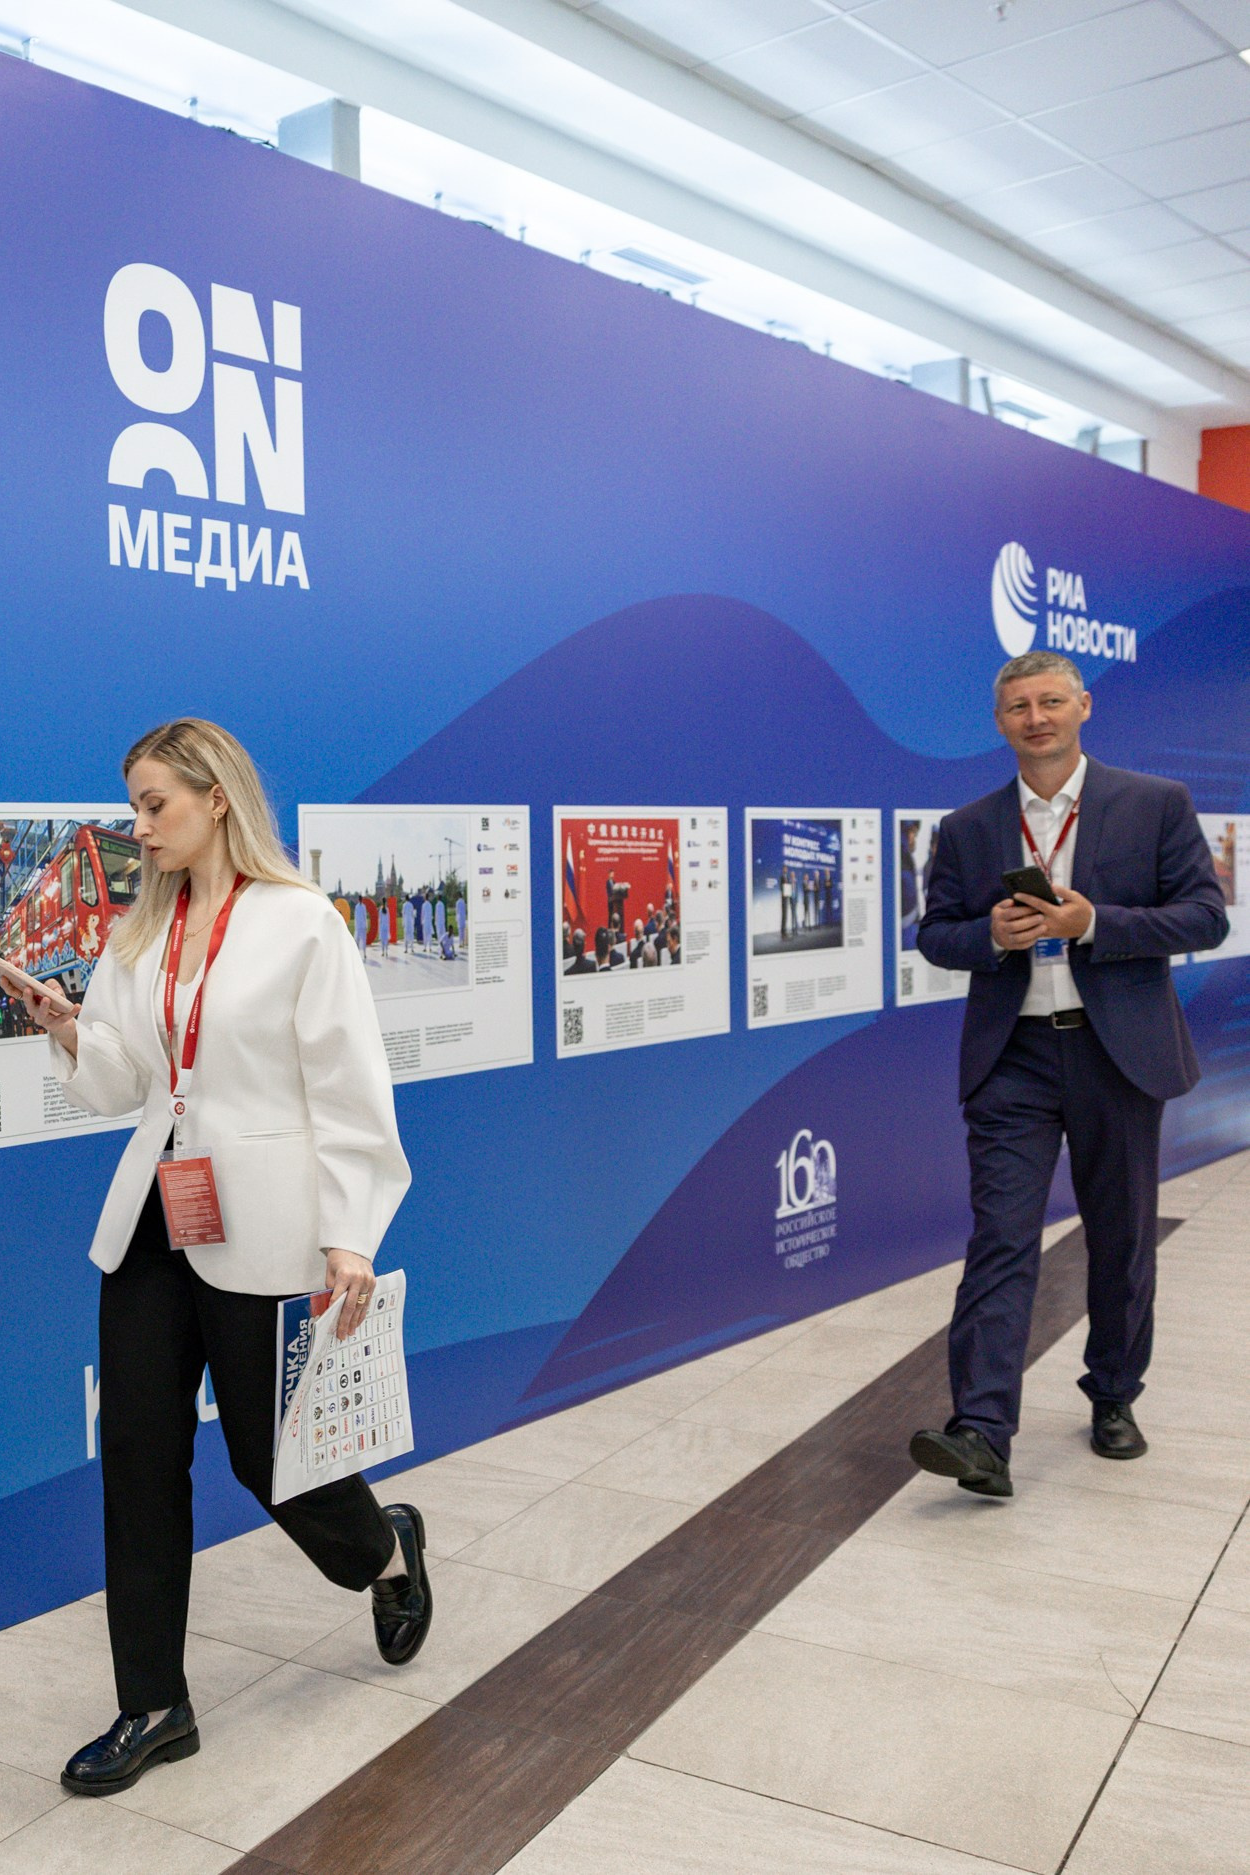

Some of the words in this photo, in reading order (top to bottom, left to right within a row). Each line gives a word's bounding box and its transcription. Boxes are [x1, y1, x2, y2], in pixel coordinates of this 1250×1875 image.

[108, 504, 310, 591] МЕДИА
[1046, 567, 1087, 612] РИА
[1047, 611, 1137, 663] НОВОСТИ
[776, 1207, 837, 1237] РОССИЙСКОЕ
[776, 1224, 837, 1255] ИСТОРИЧЕСКОЕ
[785, 1244, 830, 1270] ОБЩЕСТВО
